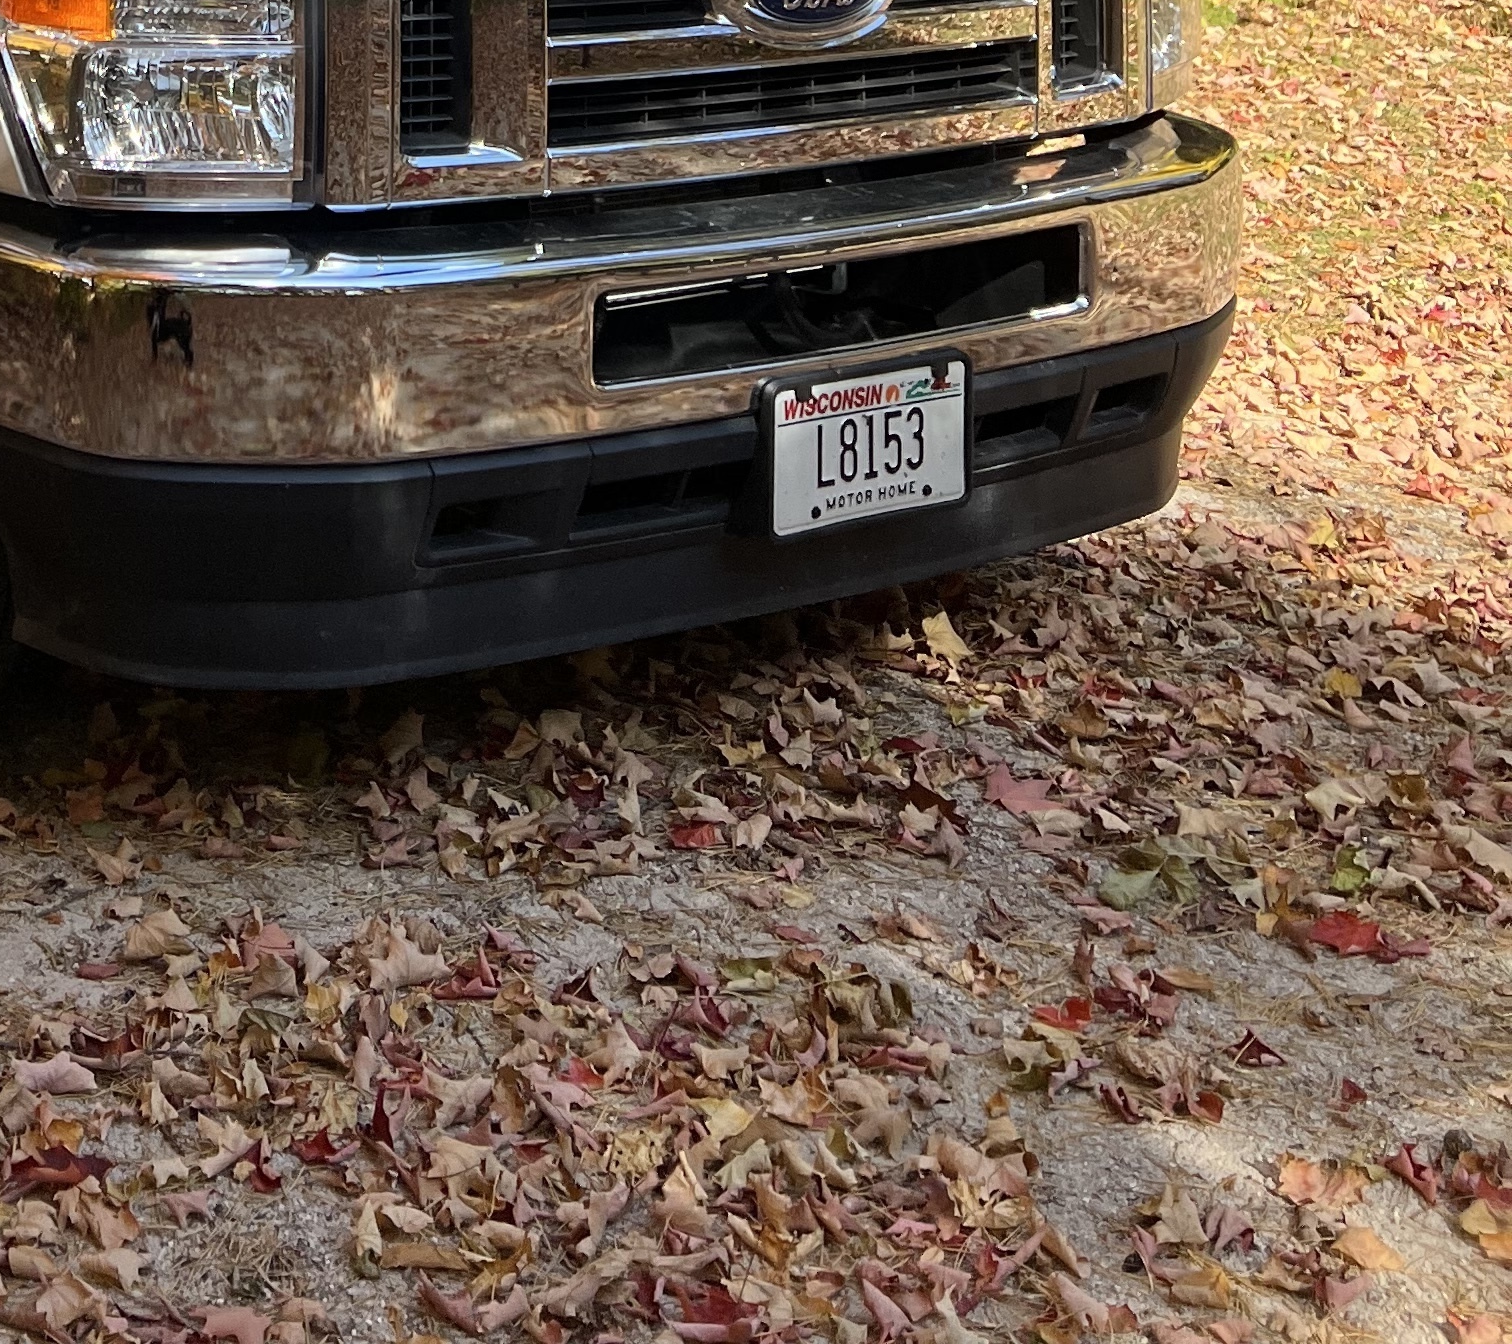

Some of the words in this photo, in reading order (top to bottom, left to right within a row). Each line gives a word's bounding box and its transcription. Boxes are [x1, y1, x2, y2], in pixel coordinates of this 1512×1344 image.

[784, 383, 884, 421] WISCONSIN
[816, 406, 925, 488] L8153
[825, 489, 873, 511] MOTOR
[878, 480, 916, 501] HOME
